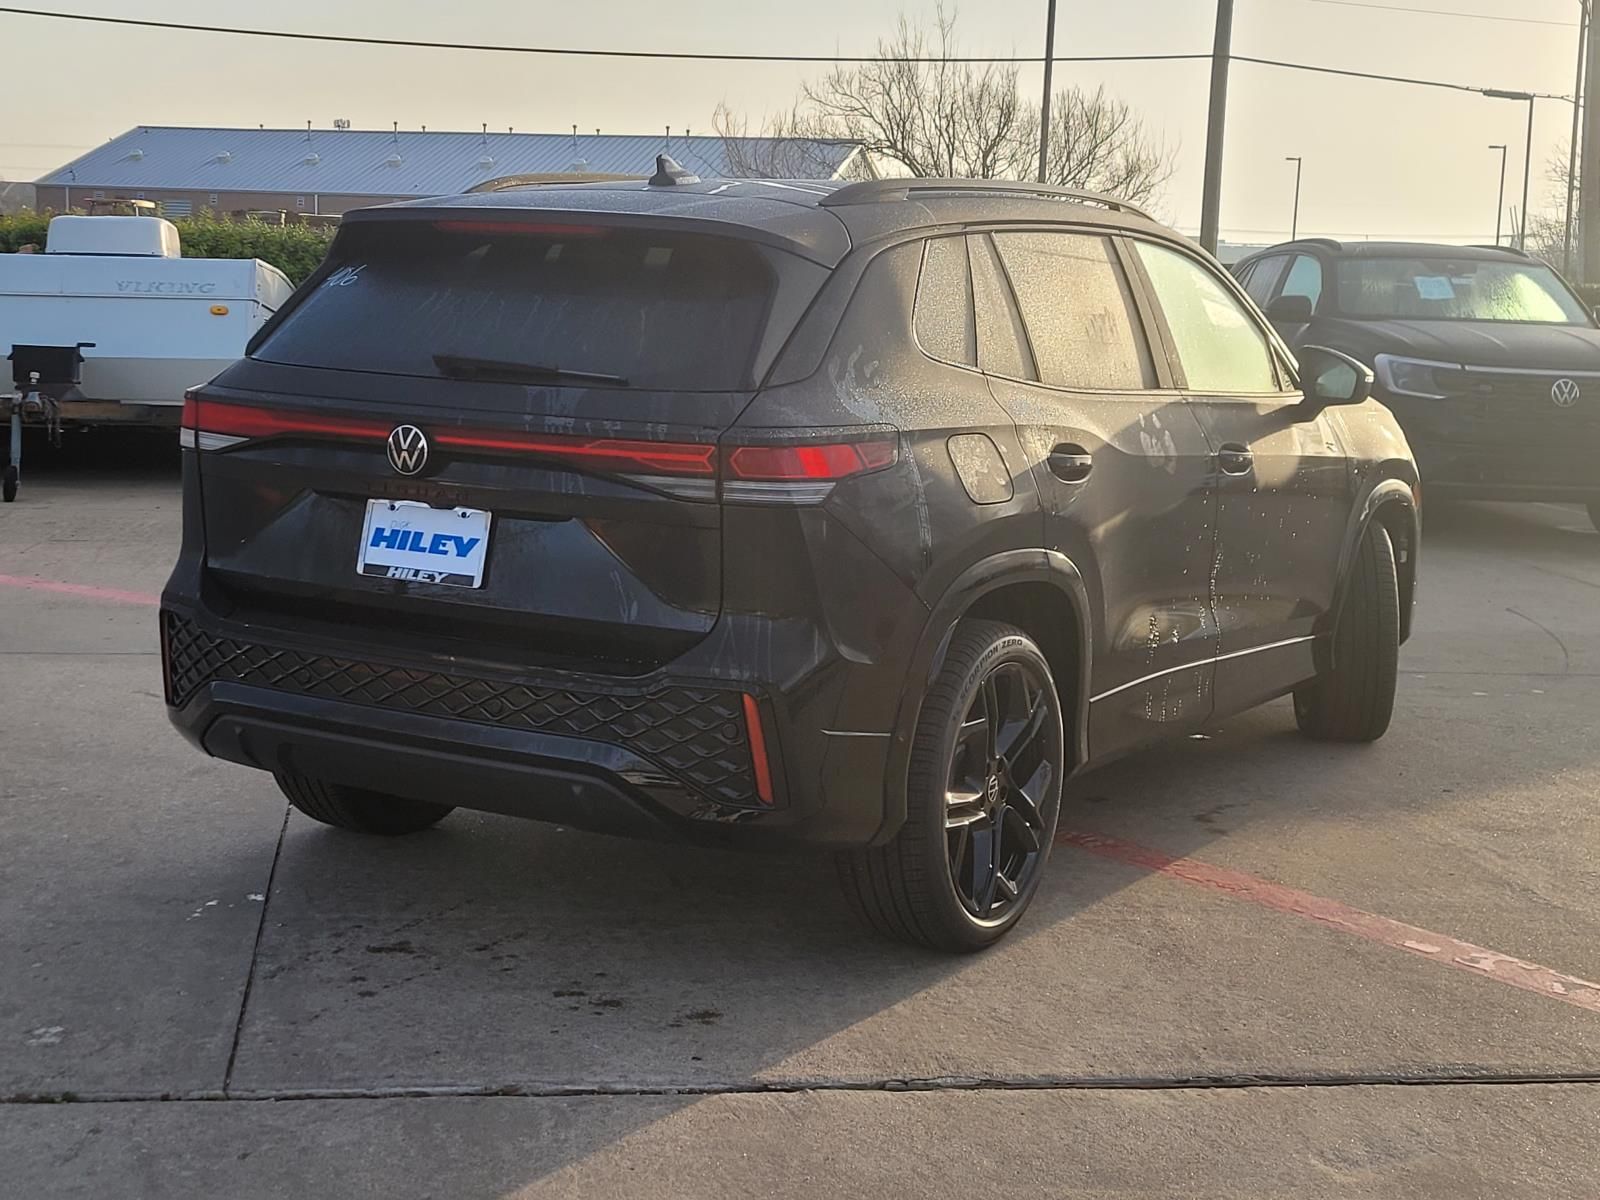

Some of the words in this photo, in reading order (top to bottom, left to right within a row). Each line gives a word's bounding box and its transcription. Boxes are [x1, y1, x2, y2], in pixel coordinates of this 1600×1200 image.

[115, 280, 216, 294] VIKING
[387, 424, 428, 475] VW
[370, 527, 480, 558] HILEY
[386, 566, 450, 583] HILEY
[1001, 638, 1023, 649] ZERO
